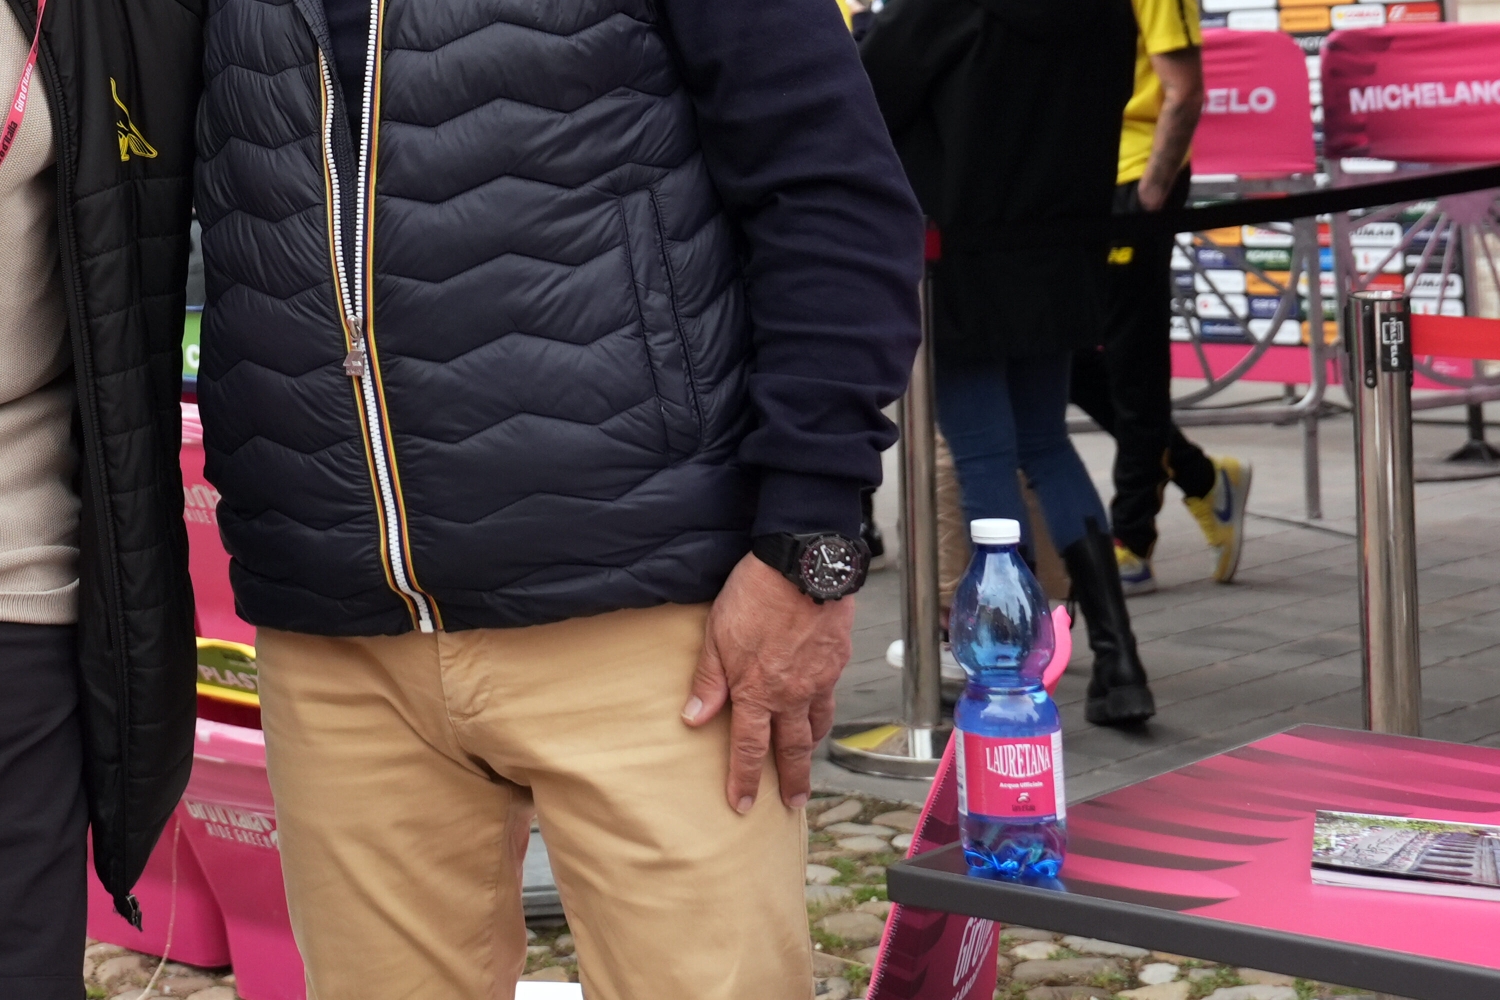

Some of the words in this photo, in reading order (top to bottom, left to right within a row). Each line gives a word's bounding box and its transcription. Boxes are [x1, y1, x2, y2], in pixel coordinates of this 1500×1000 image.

[14, 91, 26, 113] Giro
[20, 62, 33, 93] d'Italia
[1201, 85, 1276, 114] ELO
[0, 120, 18, 152] d'Italia
[985, 743, 1052, 778] LAURETANA
